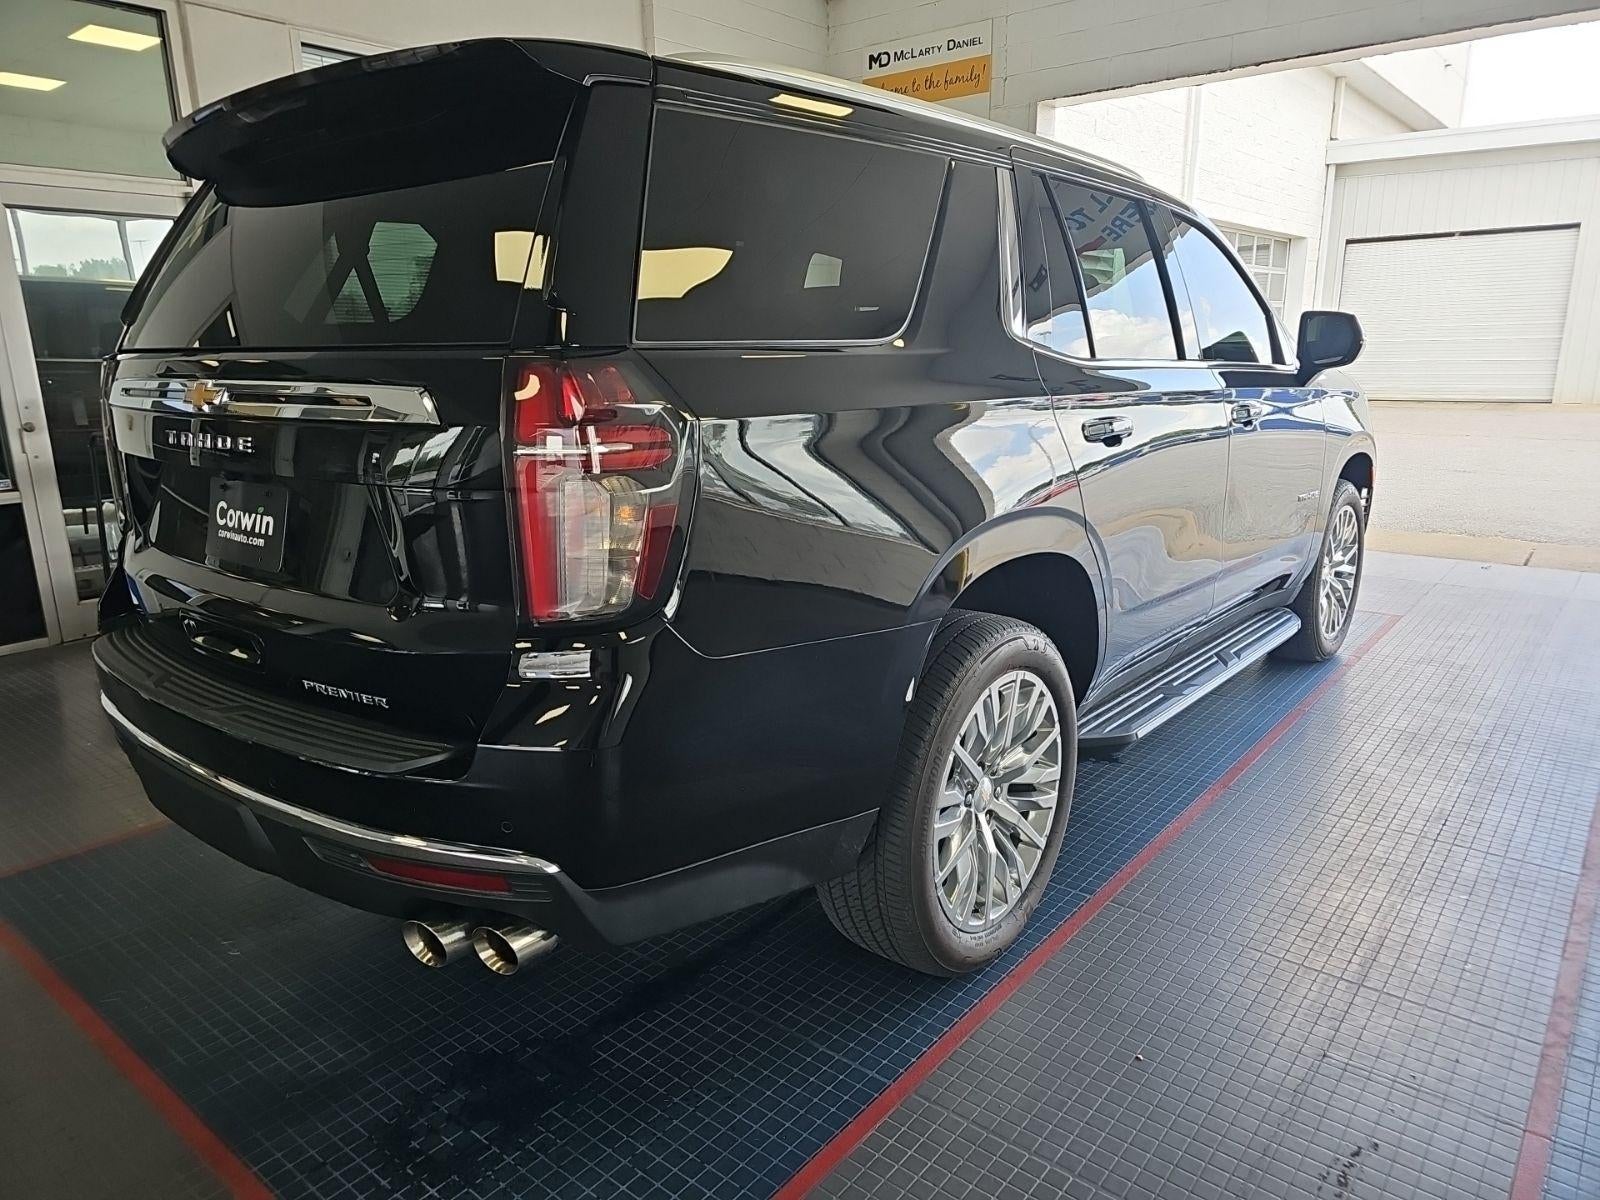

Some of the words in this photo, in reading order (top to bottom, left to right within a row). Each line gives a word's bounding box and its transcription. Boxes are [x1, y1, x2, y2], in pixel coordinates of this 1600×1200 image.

[868, 51, 891, 70] MD
[912, 77, 921, 93] to
[924, 71, 942, 90] the
[943, 64, 987, 90] family!
[165, 430, 255, 453] TAHOE
[216, 500, 274, 536] Corwin
[217, 529, 265, 547] corwinauto.com
[302, 679, 389, 709] PREMIER
